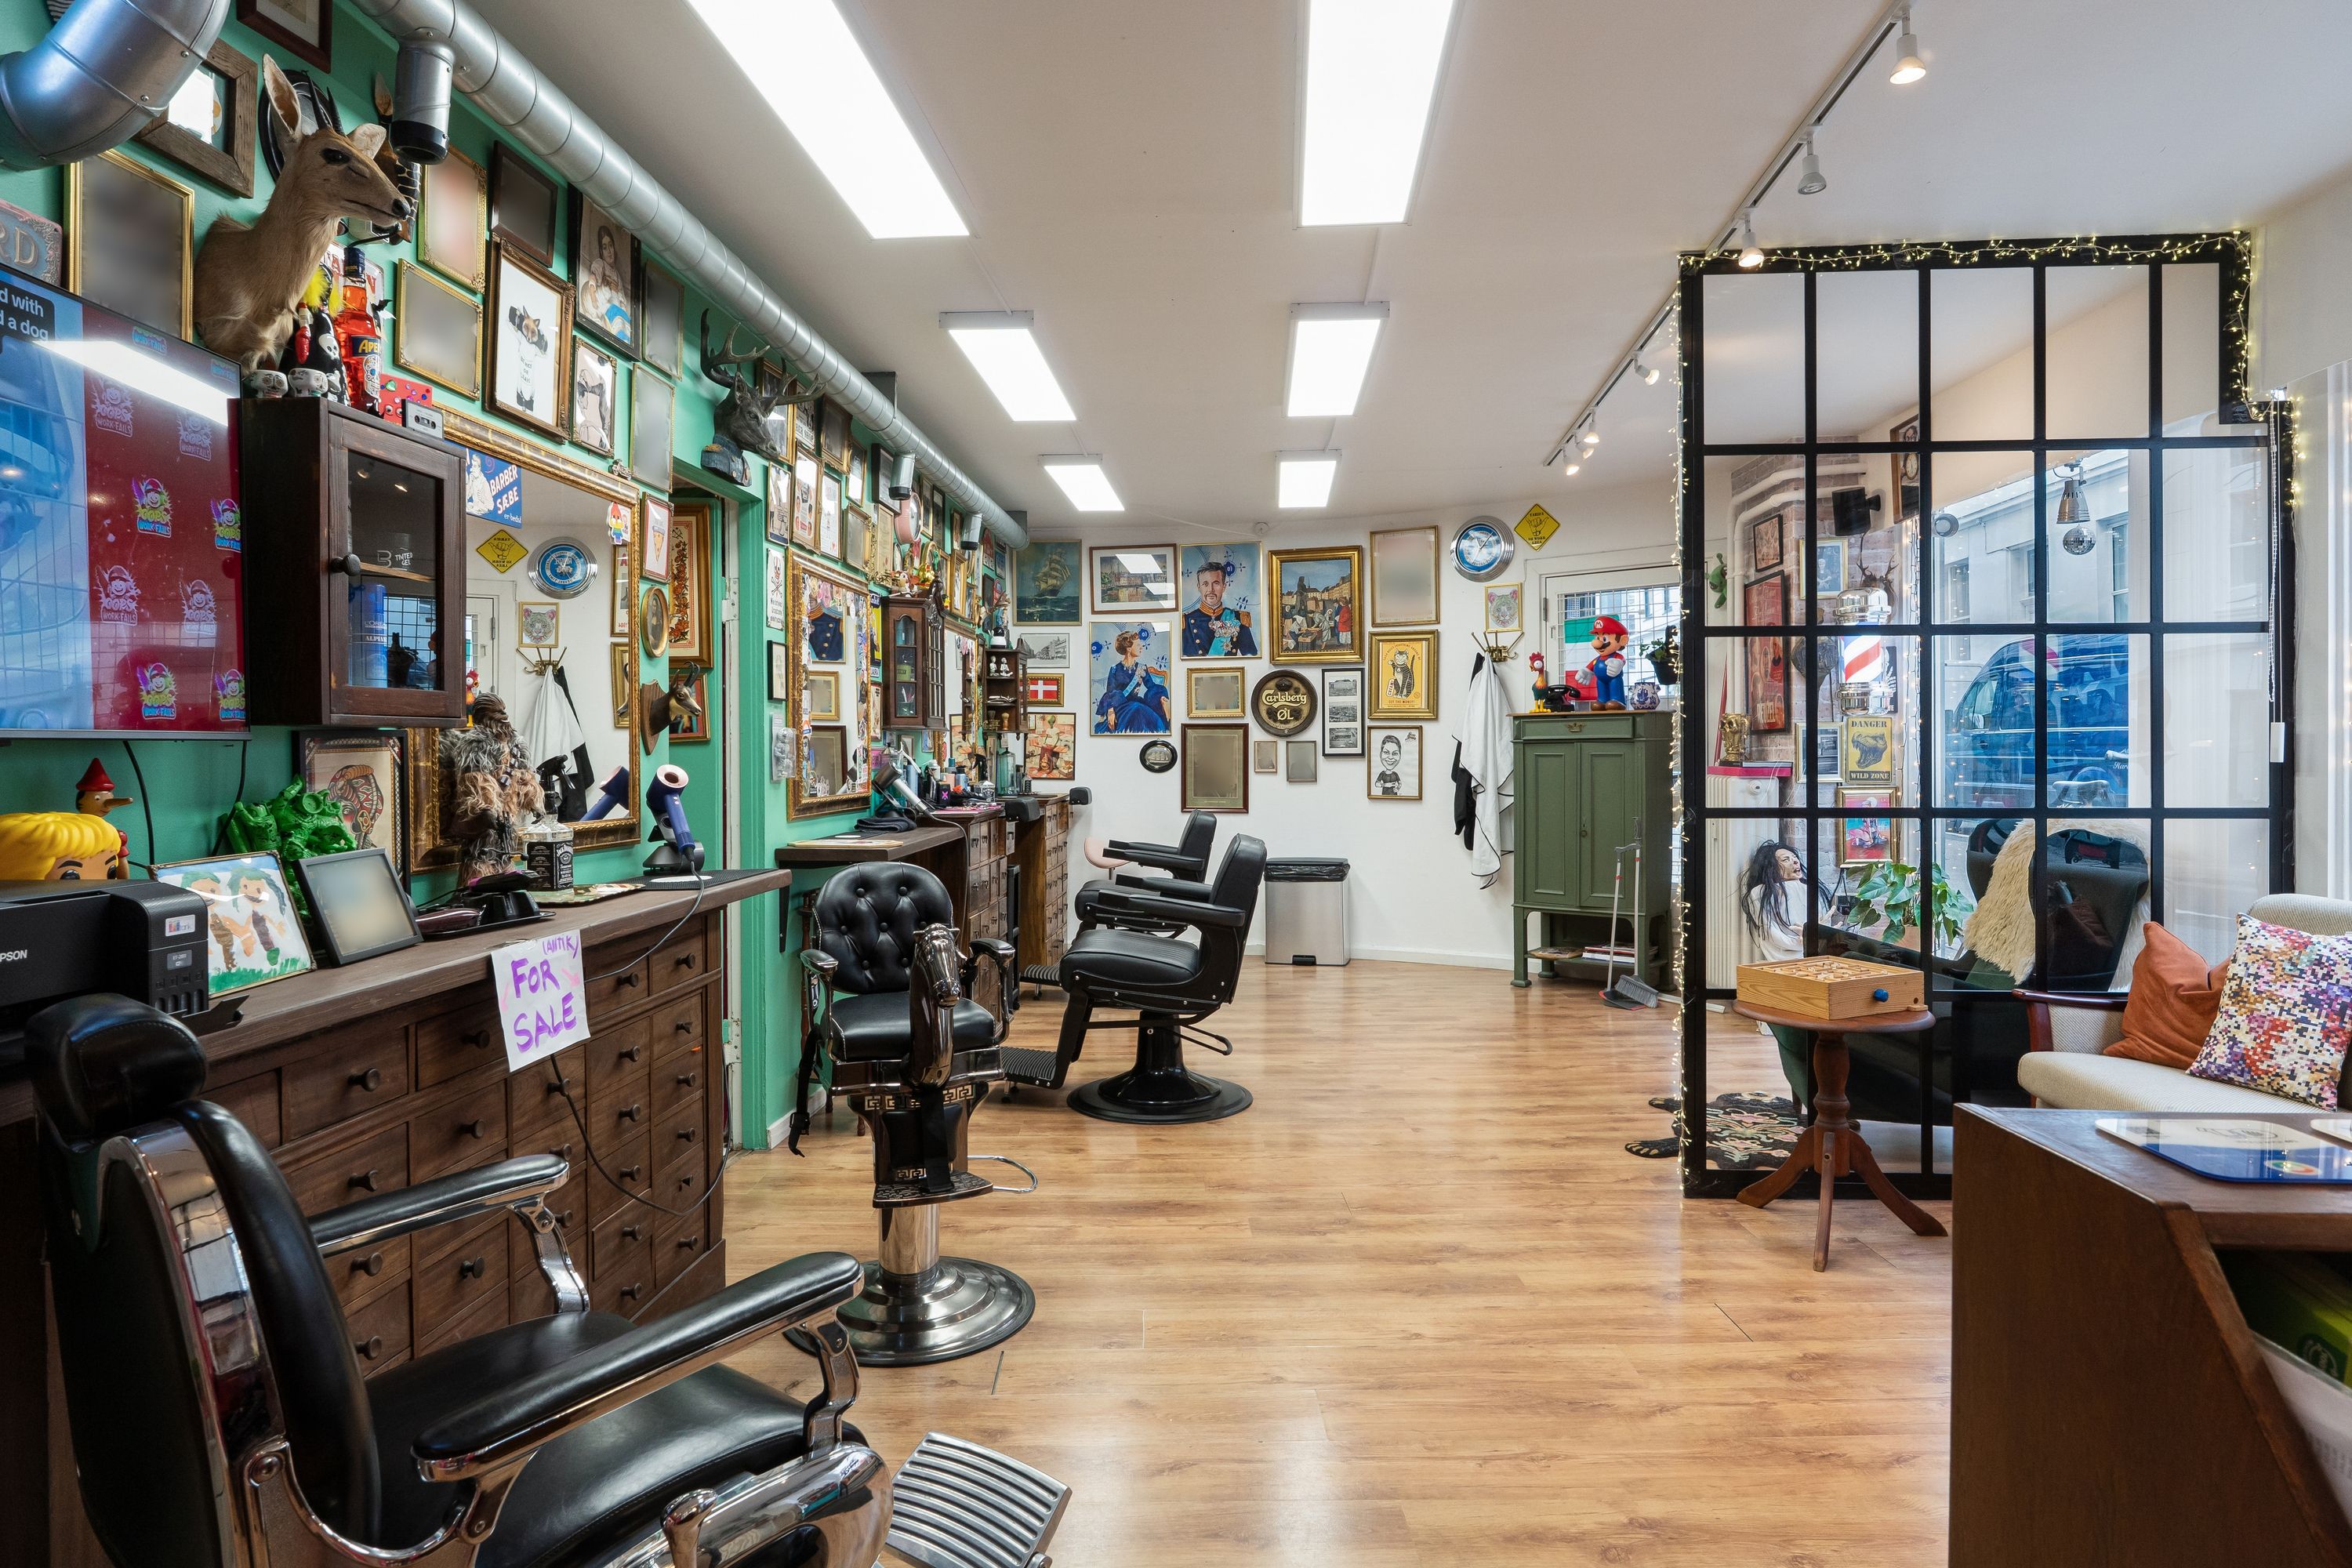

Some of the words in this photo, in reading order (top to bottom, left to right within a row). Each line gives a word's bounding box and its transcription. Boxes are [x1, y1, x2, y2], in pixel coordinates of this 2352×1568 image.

[12, 293, 44, 318] with
[20, 321, 49, 342] dog
[489, 464, 518, 497] BARBER
[496, 486, 519, 515] SÆBE
[1261, 689, 1308, 709] Carlsberg
[1276, 707, 1294, 720] ØL
[1851, 720, 1887, 728] DANGER
[1851, 771, 1869, 780] WILD
[0, 949, 27, 962] PSON
[510, 957, 561, 999] FOR
[514, 991, 576, 1053] SALE
